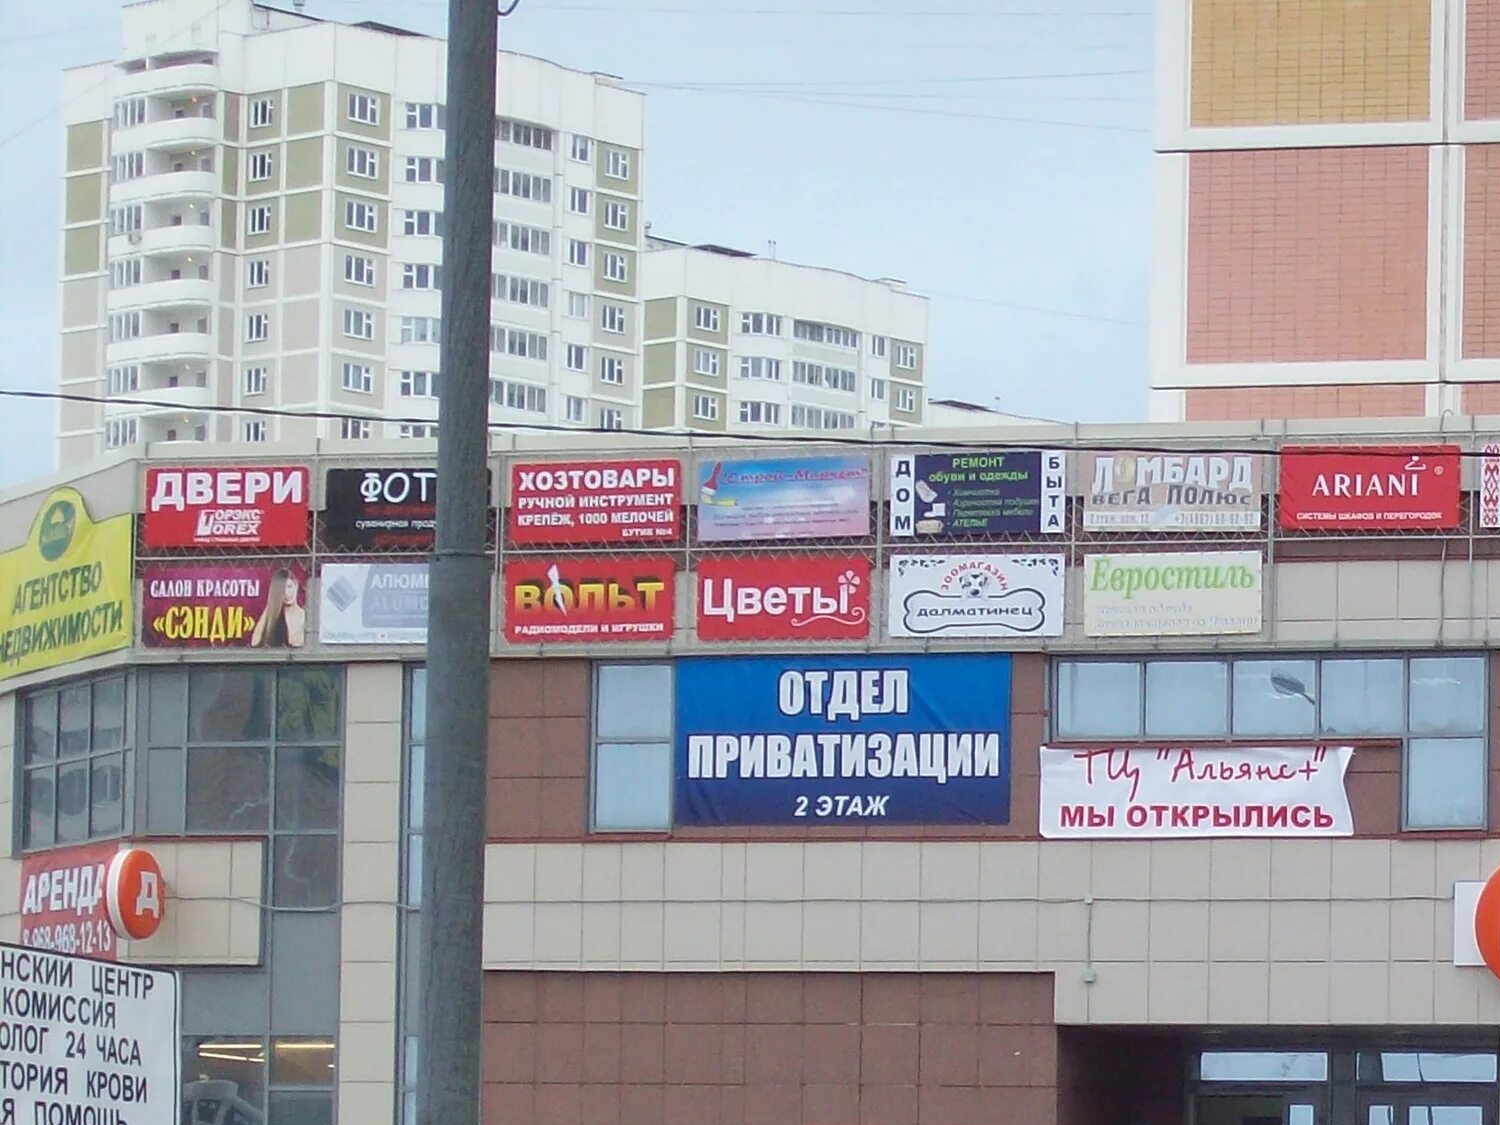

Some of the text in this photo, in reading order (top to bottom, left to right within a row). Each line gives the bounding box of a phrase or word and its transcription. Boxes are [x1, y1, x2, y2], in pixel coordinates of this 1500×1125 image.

[518, 468, 674, 491] ХОЗТОВАРЫ
[929, 472, 965, 484] обуви
[979, 471, 1028, 482] одежды
[953, 457, 1004, 469] РЕМОНТ
[151, 471, 302, 511] ДВЕРИ
[360, 472, 437, 503] ФОТ
[518, 493, 674, 509] РУЧНОЙ ИНСТРУМЕНТ
[895, 460, 911, 530] ДОМ
[1046, 456, 1062, 527] БЫТА
[1312, 473, 1419, 498] ARIANI
[579, 513, 607, 525] 1000
[611, 509, 674, 524] МЕЛОЧЕЙ
[12, 560, 103, 616] АГЕНТСТВО
[151, 580, 260, 598] САЛОН КРАСОТЫ
[941, 561, 1008, 591] ЗООМАГАЗИН
[1091, 559, 1254, 600] Евростиль
[514, 582, 665, 614] ВОЛЬТ
[703, 578, 849, 623] Цветы
[153, 606, 255, 643] «СЭНДИ»
[515, 623, 664, 635] РАДИОМОДЕЛИ И ИГРУШКИ
[778, 670, 908, 720] ОТДЕЛ
[688, 733, 999, 784] ПРИВАТИЗАЦИИ
[1073, 749, 1139, 802] ТЦ
[794, 795, 890, 817] 2 ЭТАЖ
[1060, 804, 1333, 829] МЫ ОТКРЫЛИСЬ
[135, 871, 160, 919] Д
[91, 965, 154, 1000] ЦЕНТР
[3, 986, 117, 1029] КОМИССИЯ
[0, 1022, 142, 1066] ОЛОГ 24 ЧАСА
[0, 1061, 147, 1103] ТОРИЯ КРОВИ
